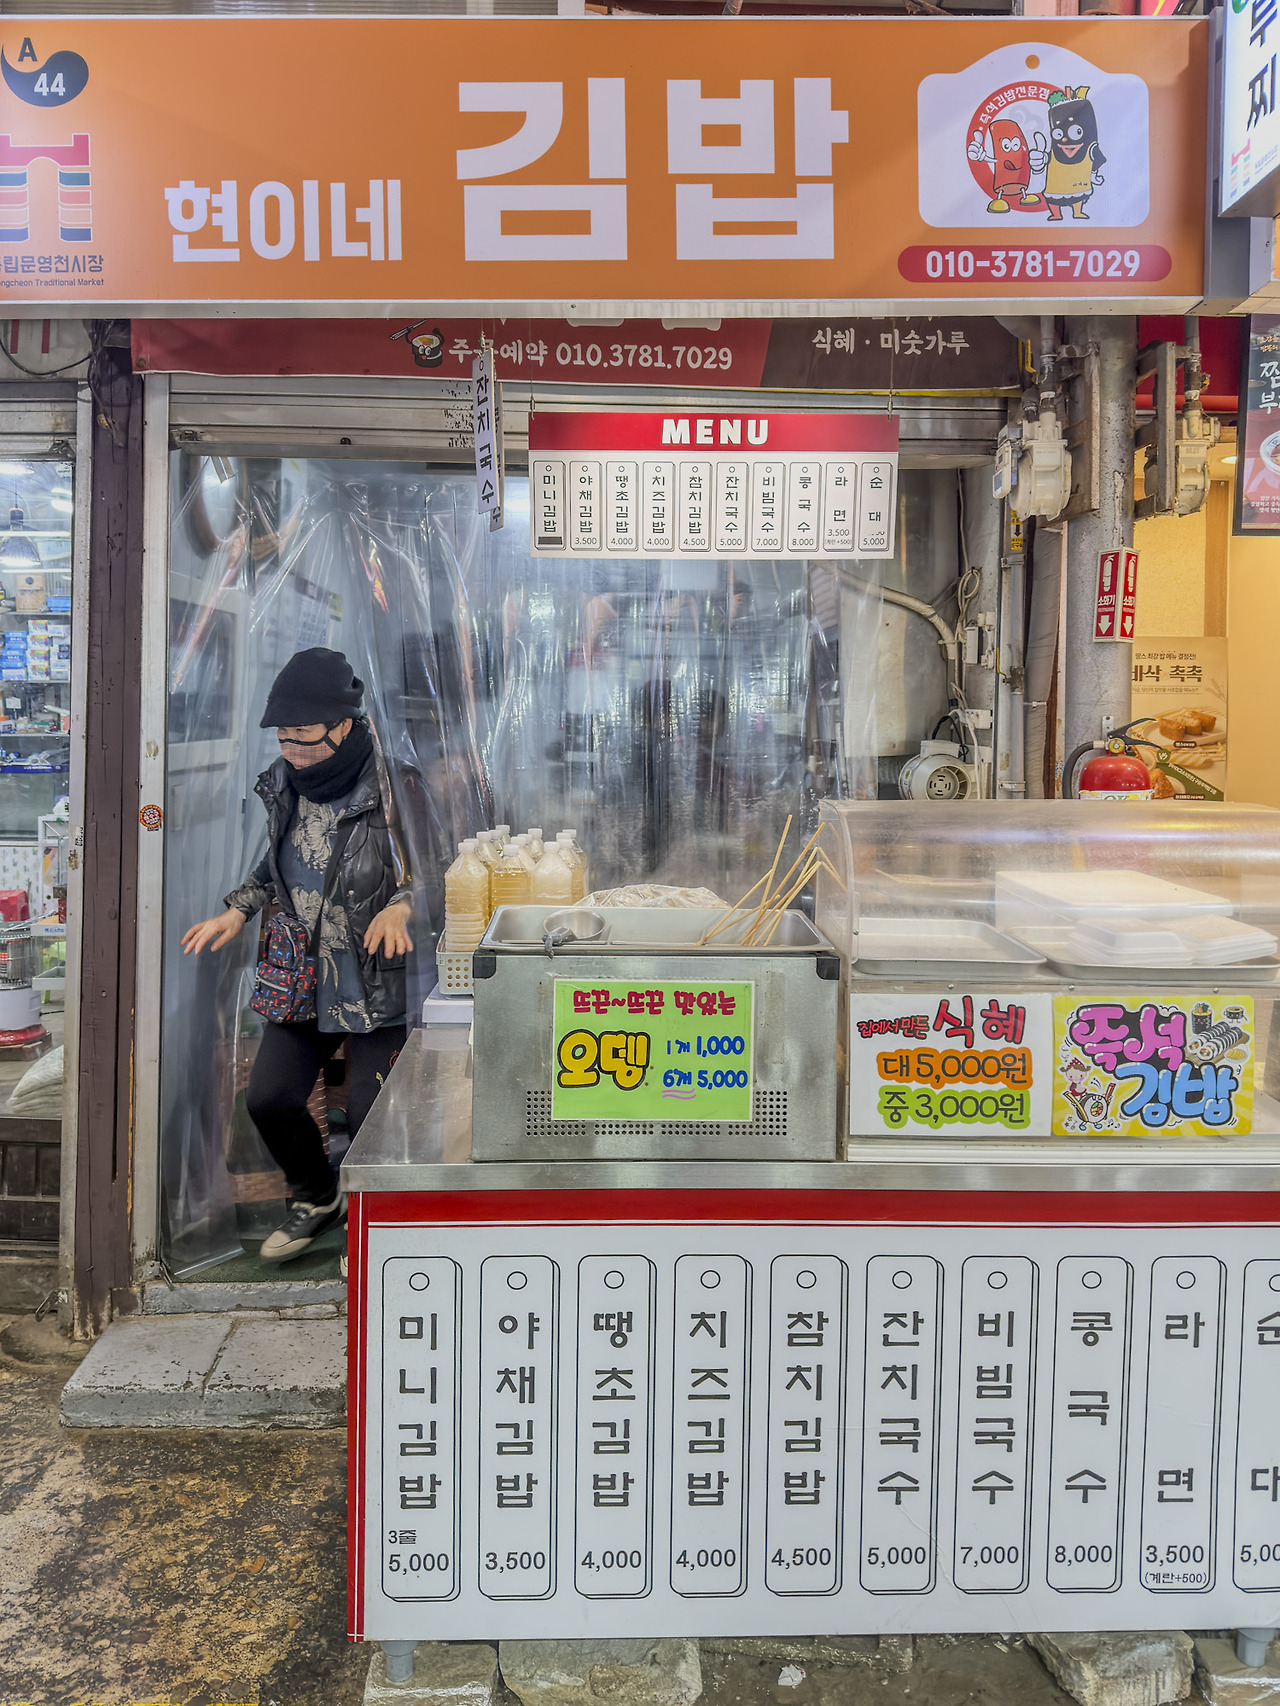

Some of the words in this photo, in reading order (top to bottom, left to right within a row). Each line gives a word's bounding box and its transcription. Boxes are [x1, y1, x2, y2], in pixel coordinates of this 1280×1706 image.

[18, 37, 38, 62] A
[34, 72, 66, 97] 44
[164, 179, 403, 263] 현이네
[456, 77, 850, 262] 김밥
[0, 254, 104, 274] 립문영천시장
[925, 249, 1141, 279] 010-3781-7029
[35, 278, 76, 287] Traditional
[78, 278, 104, 286] Market
[812, 327, 856, 355] 식혜
[879, 328, 970, 356] 미숫가루
[556, 342, 733, 370] 010.3781.7029
[476, 374, 495, 504] 잔치국수
[660, 418, 770, 447] MENU
[543, 475, 557, 533] 미니김밥
[579, 475, 593, 533] 야채김밥
[615, 475, 629, 534] 땡초김밥
[652, 475, 666, 534] 치즈김밥
[688, 475, 703, 534] 참치김밥
[725, 476, 740, 533] 잔치국수
[761, 476, 775, 533] 비빔국수
[797, 476, 812, 533] 콩국수
[833, 476, 849, 522] 라면
[868, 476, 884, 522] 순대
[575, 536, 597, 545] 3.500
[610, 537, 634, 545] 4.000
[646, 537, 670, 546] 4.000
[683, 538, 706, 546] 4.500
[719, 538, 743, 546] 5.000
[756, 538, 779, 546] 7.000
[791, 538, 815, 546] 8.000
[828, 529, 850, 537] 3.500
[863, 537, 885, 546] 5.000
[1169, 664, 1203, 683] 촉촉
[674, 990, 736, 1016] 맛있는
[857, 1019, 900, 1039] 집에서
[900, 1015, 930, 1040] 만든
[1069, 1004, 1187, 1073] 즉석
[557, 1028, 650, 1091] 오뎅
[696, 1035, 745, 1058] 1,000
[662, 1068, 692, 1088] 6개
[697, 1069, 748, 1090] 5,000
[882, 1055, 910, 1077] 대
[916, 1053, 1027, 1084] 5,000원
[884, 1091, 909, 1123] 중
[915, 1093, 1025, 1124] 3,000원
[399, 1312, 442, 1510] 미니김밥
[495, 1311, 541, 1509] 야채김밥
[592, 1311, 636, 1508] 땡초김밥
[687, 1310, 731, 1507] 치즈김밥
[784, 1310, 829, 1505] 참치김밥
[877, 1310, 925, 1505] 잔치국수
[971, 1310, 1016, 1505] 비빔국수
[1064, 1311, 1113, 1504] 콩국수
[1157, 1311, 1206, 1503] 라면
[388, 1529, 417, 1545] 3줄
[389, 1553, 450, 1575] 5,000
[485, 1551, 546, 1573] 3,500
[581, 1549, 643, 1572] 4,000
[676, 1548, 737, 1571] 4,000
[771, 1547, 832, 1569] 4,500
[867, 1546, 927, 1567] 5,000
[960, 1545, 1020, 1567] 7,000
[1054, 1544, 1113, 1566] 8,000
[1145, 1544, 1205, 1565] 3,500
